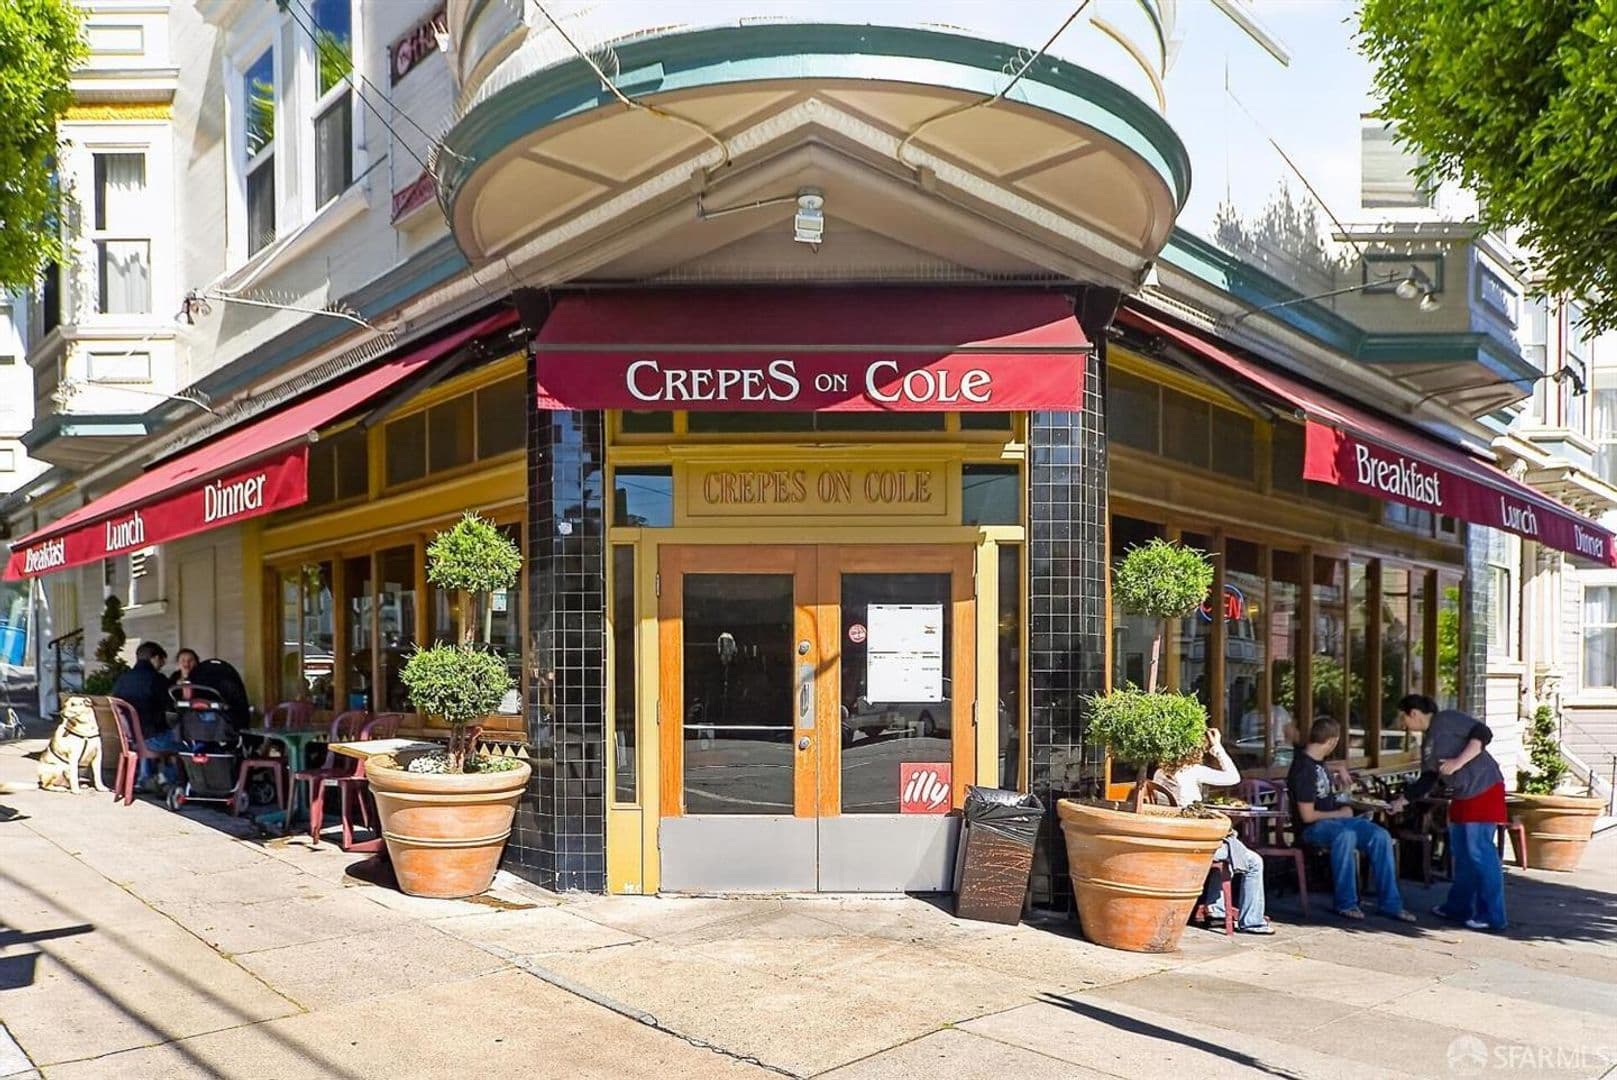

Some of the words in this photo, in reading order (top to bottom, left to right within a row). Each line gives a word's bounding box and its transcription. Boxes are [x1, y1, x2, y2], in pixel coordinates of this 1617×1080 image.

[627, 360, 801, 402] CREPES
[815, 373, 849, 393] ON
[703, 471, 807, 505] CREPES
[817, 471, 853, 505] ON
[863, 471, 932, 505] COLE
[1356, 443, 1442, 506] Breakfast
[1501, 496, 1538, 535] Lunch
[1574, 525, 1604, 558] Dinner
[24, 538, 66, 573] Breakfast
[106, 511, 145, 551] Lunch
[204, 473, 267, 523] Dinner
[903, 770, 950, 811] illy
